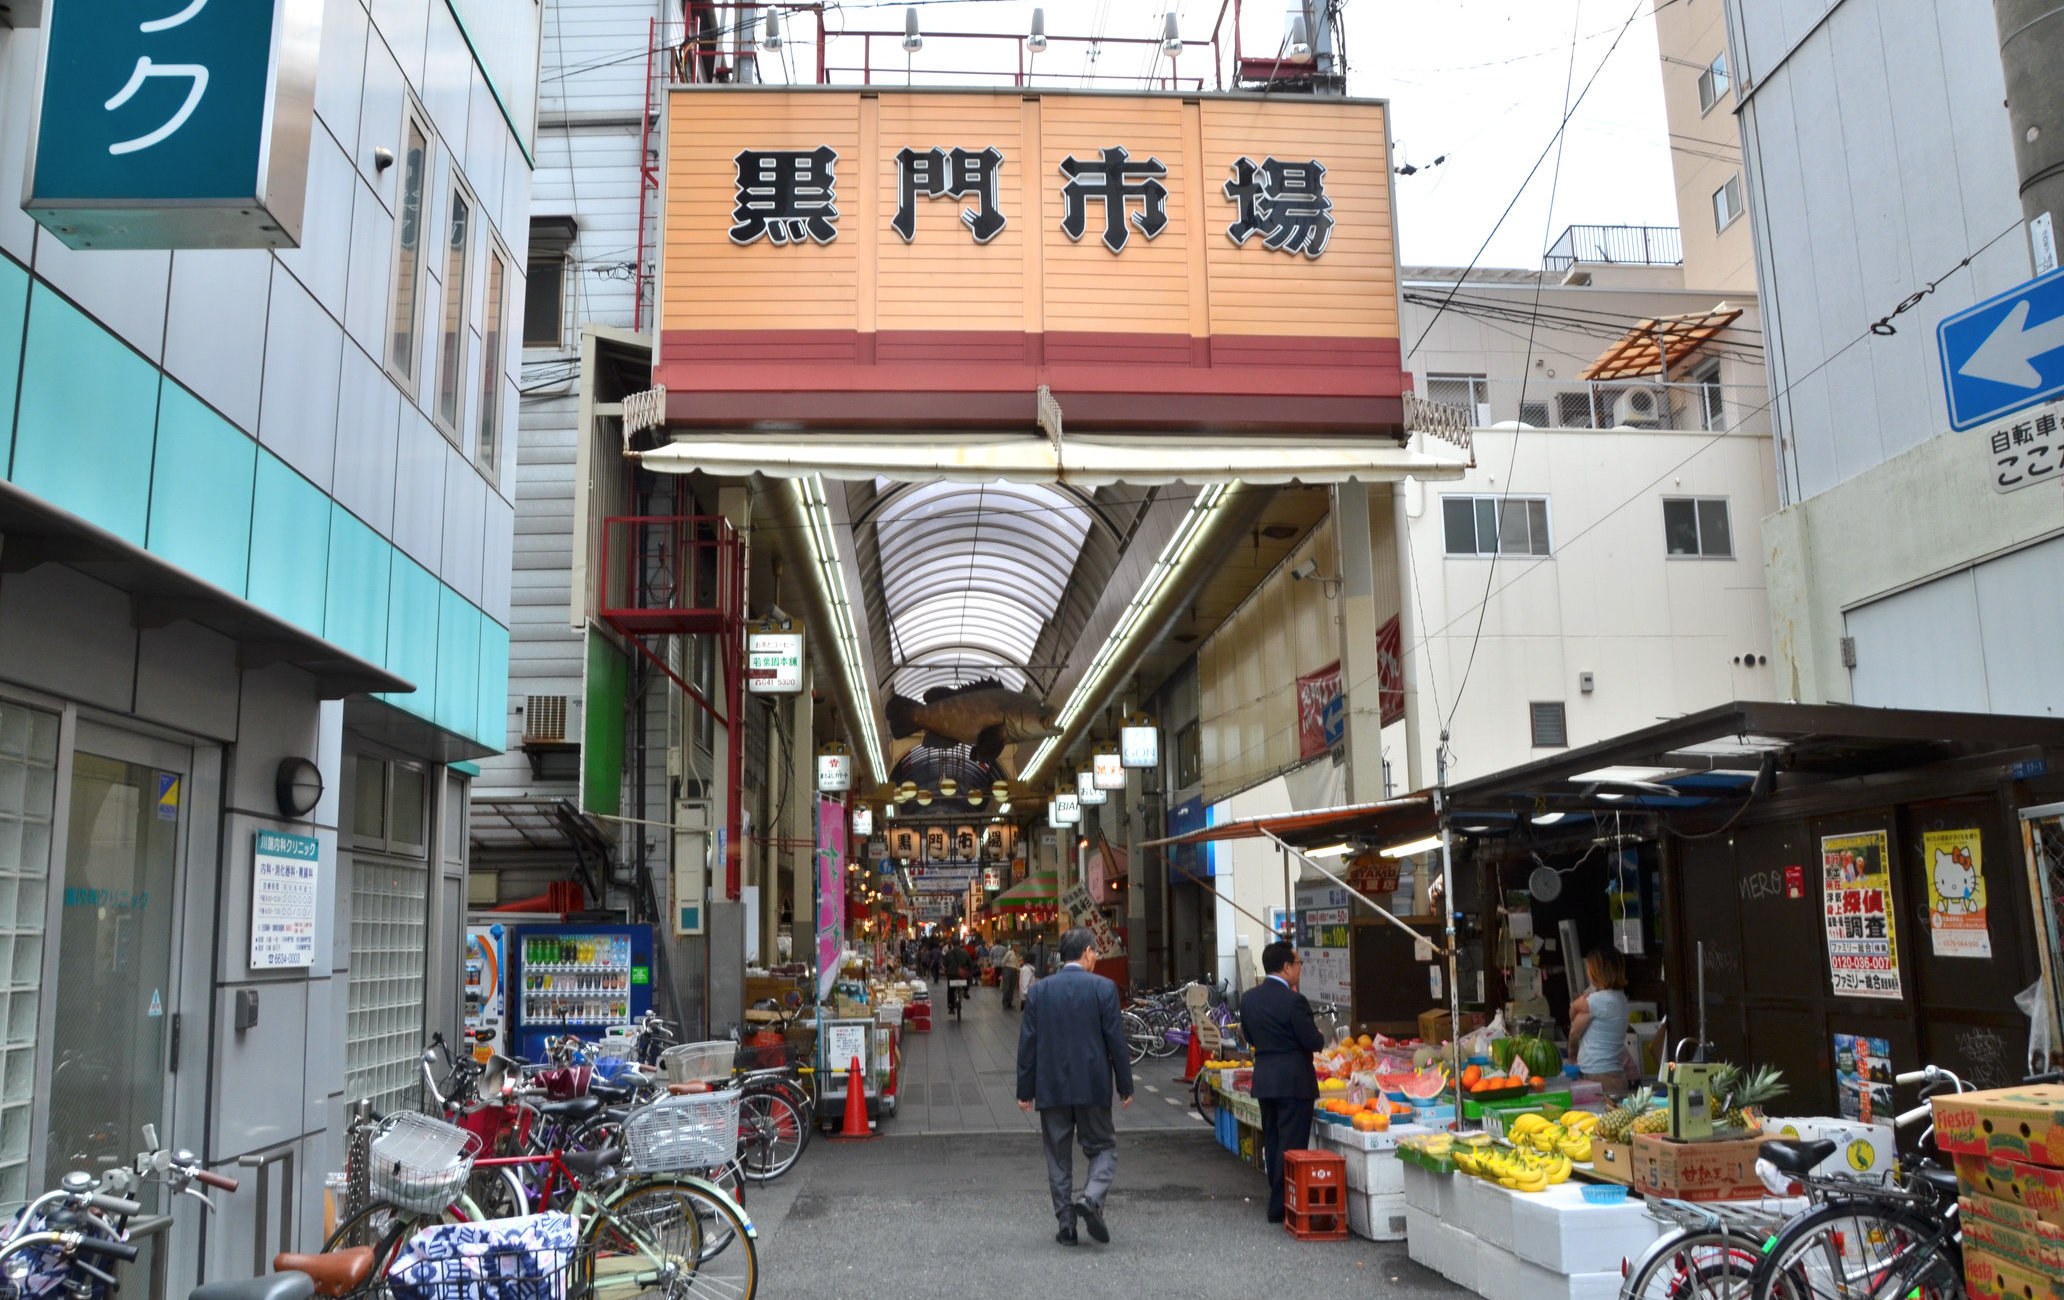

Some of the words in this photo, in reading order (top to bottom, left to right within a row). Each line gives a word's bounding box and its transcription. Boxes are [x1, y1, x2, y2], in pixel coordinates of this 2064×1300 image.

[729, 145, 1335, 259] 黒門市場
[1992, 413, 2064, 454] 自転車
[1843, 889, 1884, 914] 探偵
[1844, 915, 1887, 938] 調査
[1832, 956, 1890, 969] 0120-036-007
[1937, 1109, 1976, 1130] Fiesta
[1965, 1257, 1993, 1281] Fiesta
